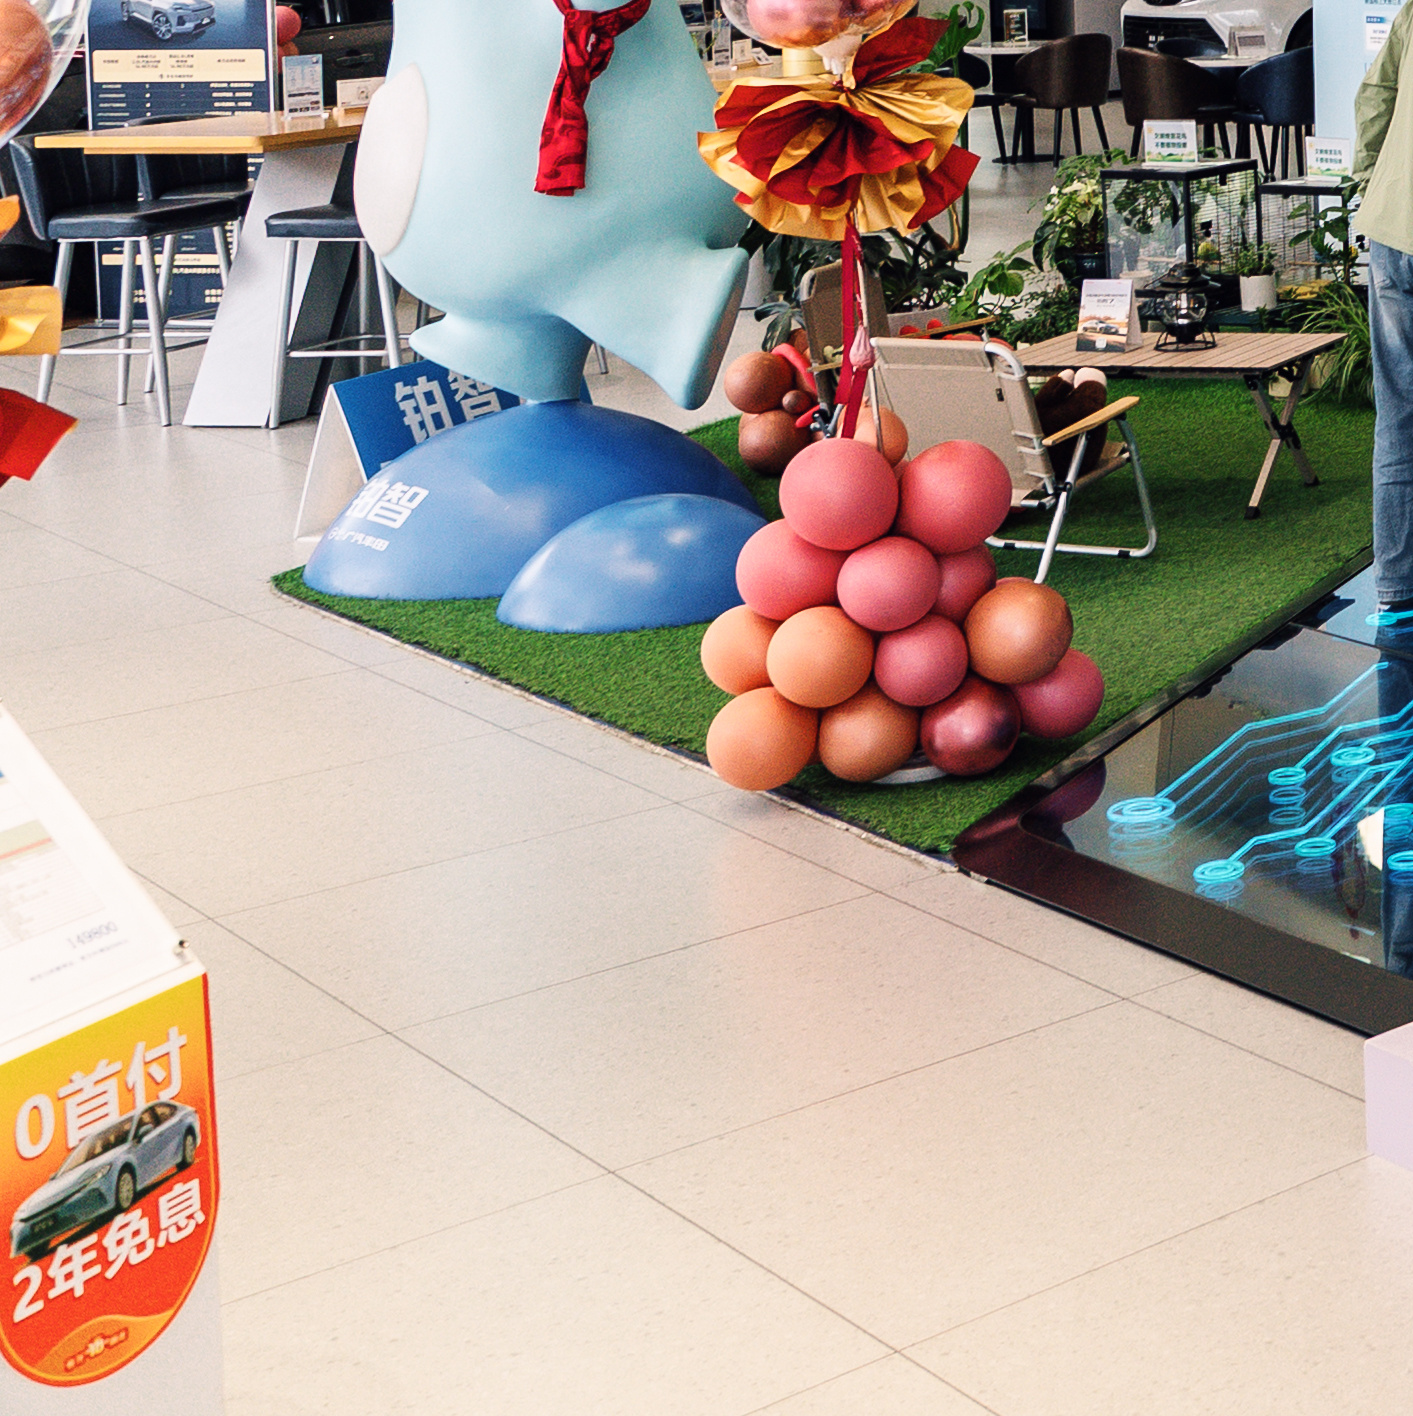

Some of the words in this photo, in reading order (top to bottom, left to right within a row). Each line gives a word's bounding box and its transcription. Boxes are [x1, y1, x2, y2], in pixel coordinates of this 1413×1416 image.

[14, 1025, 188, 1160] 0首付
[13, 1177, 206, 1324] 2年免息
